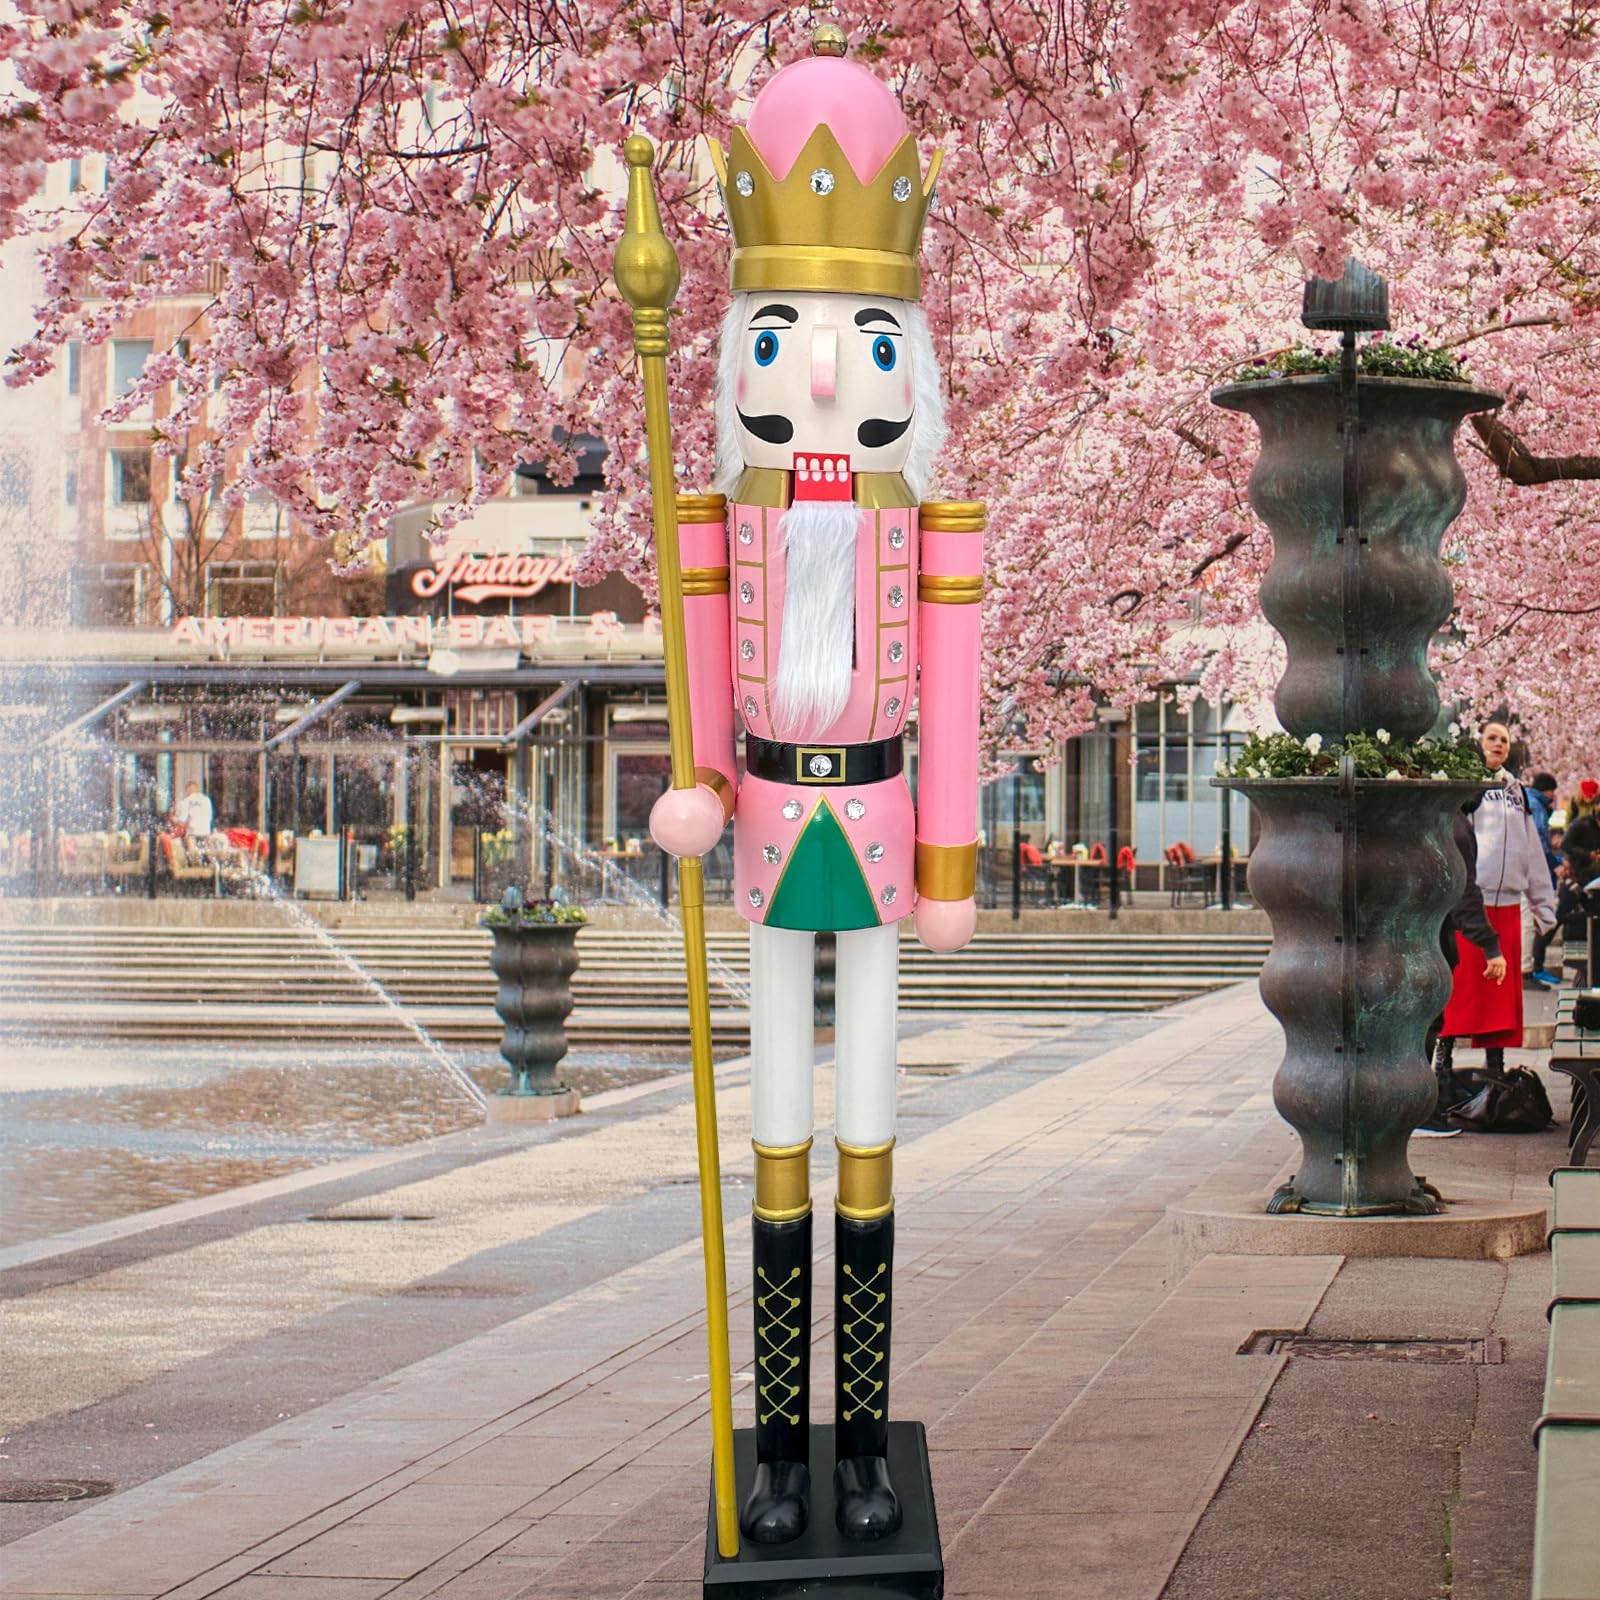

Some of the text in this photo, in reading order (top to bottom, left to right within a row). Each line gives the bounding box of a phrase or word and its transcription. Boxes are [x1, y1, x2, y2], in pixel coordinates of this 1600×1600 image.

[171, 615, 430, 646] AMERICAN
[450, 614, 557, 646] BAR
[586, 610, 626, 642] &
